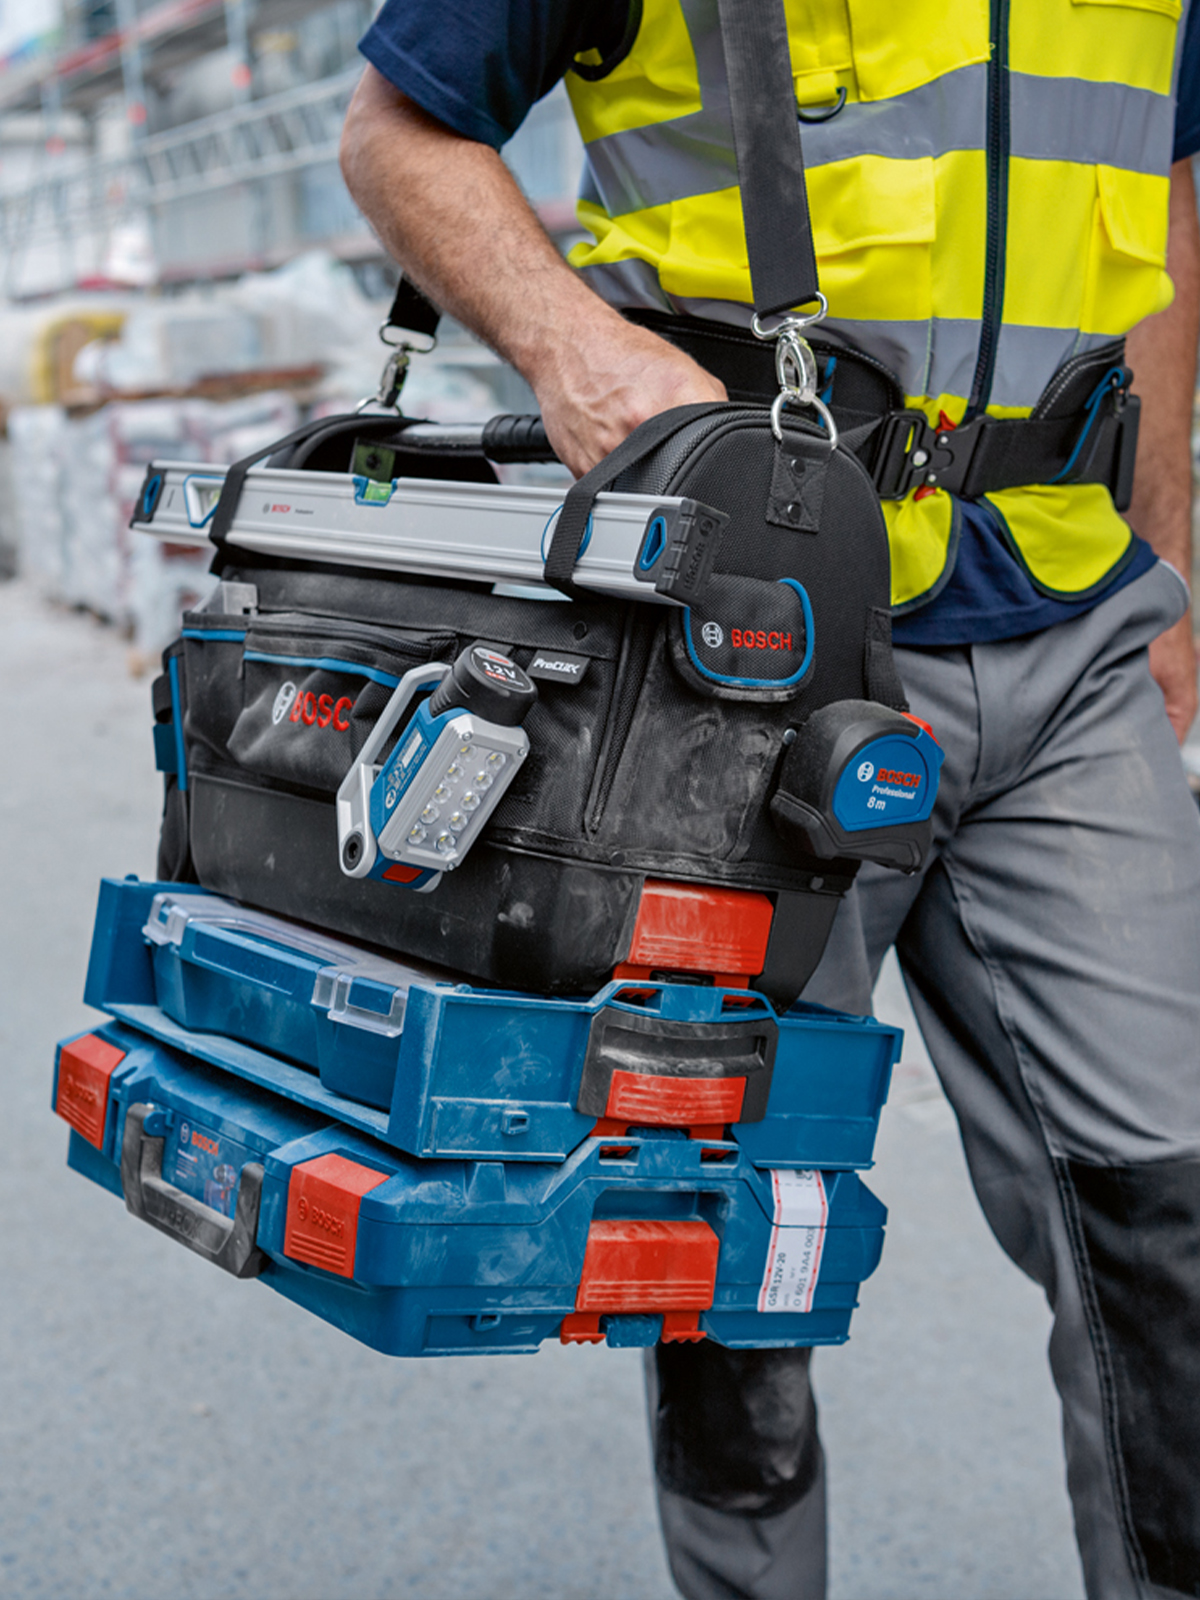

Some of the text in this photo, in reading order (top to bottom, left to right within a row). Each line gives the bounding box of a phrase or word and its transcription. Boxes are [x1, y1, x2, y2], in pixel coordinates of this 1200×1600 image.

[731, 628, 792, 651] BOSCH
[483, 661, 516, 679] 12V
[289, 690, 356, 732] BOSC
[876, 768, 922, 788] BOSCH
[872, 784, 916, 800] Professional
[191, 1131, 219, 1157] BOSCH
[311, 1205, 345, 1239] BOSCH
[768, 1252, 786, 1307] GSR 12V-20
